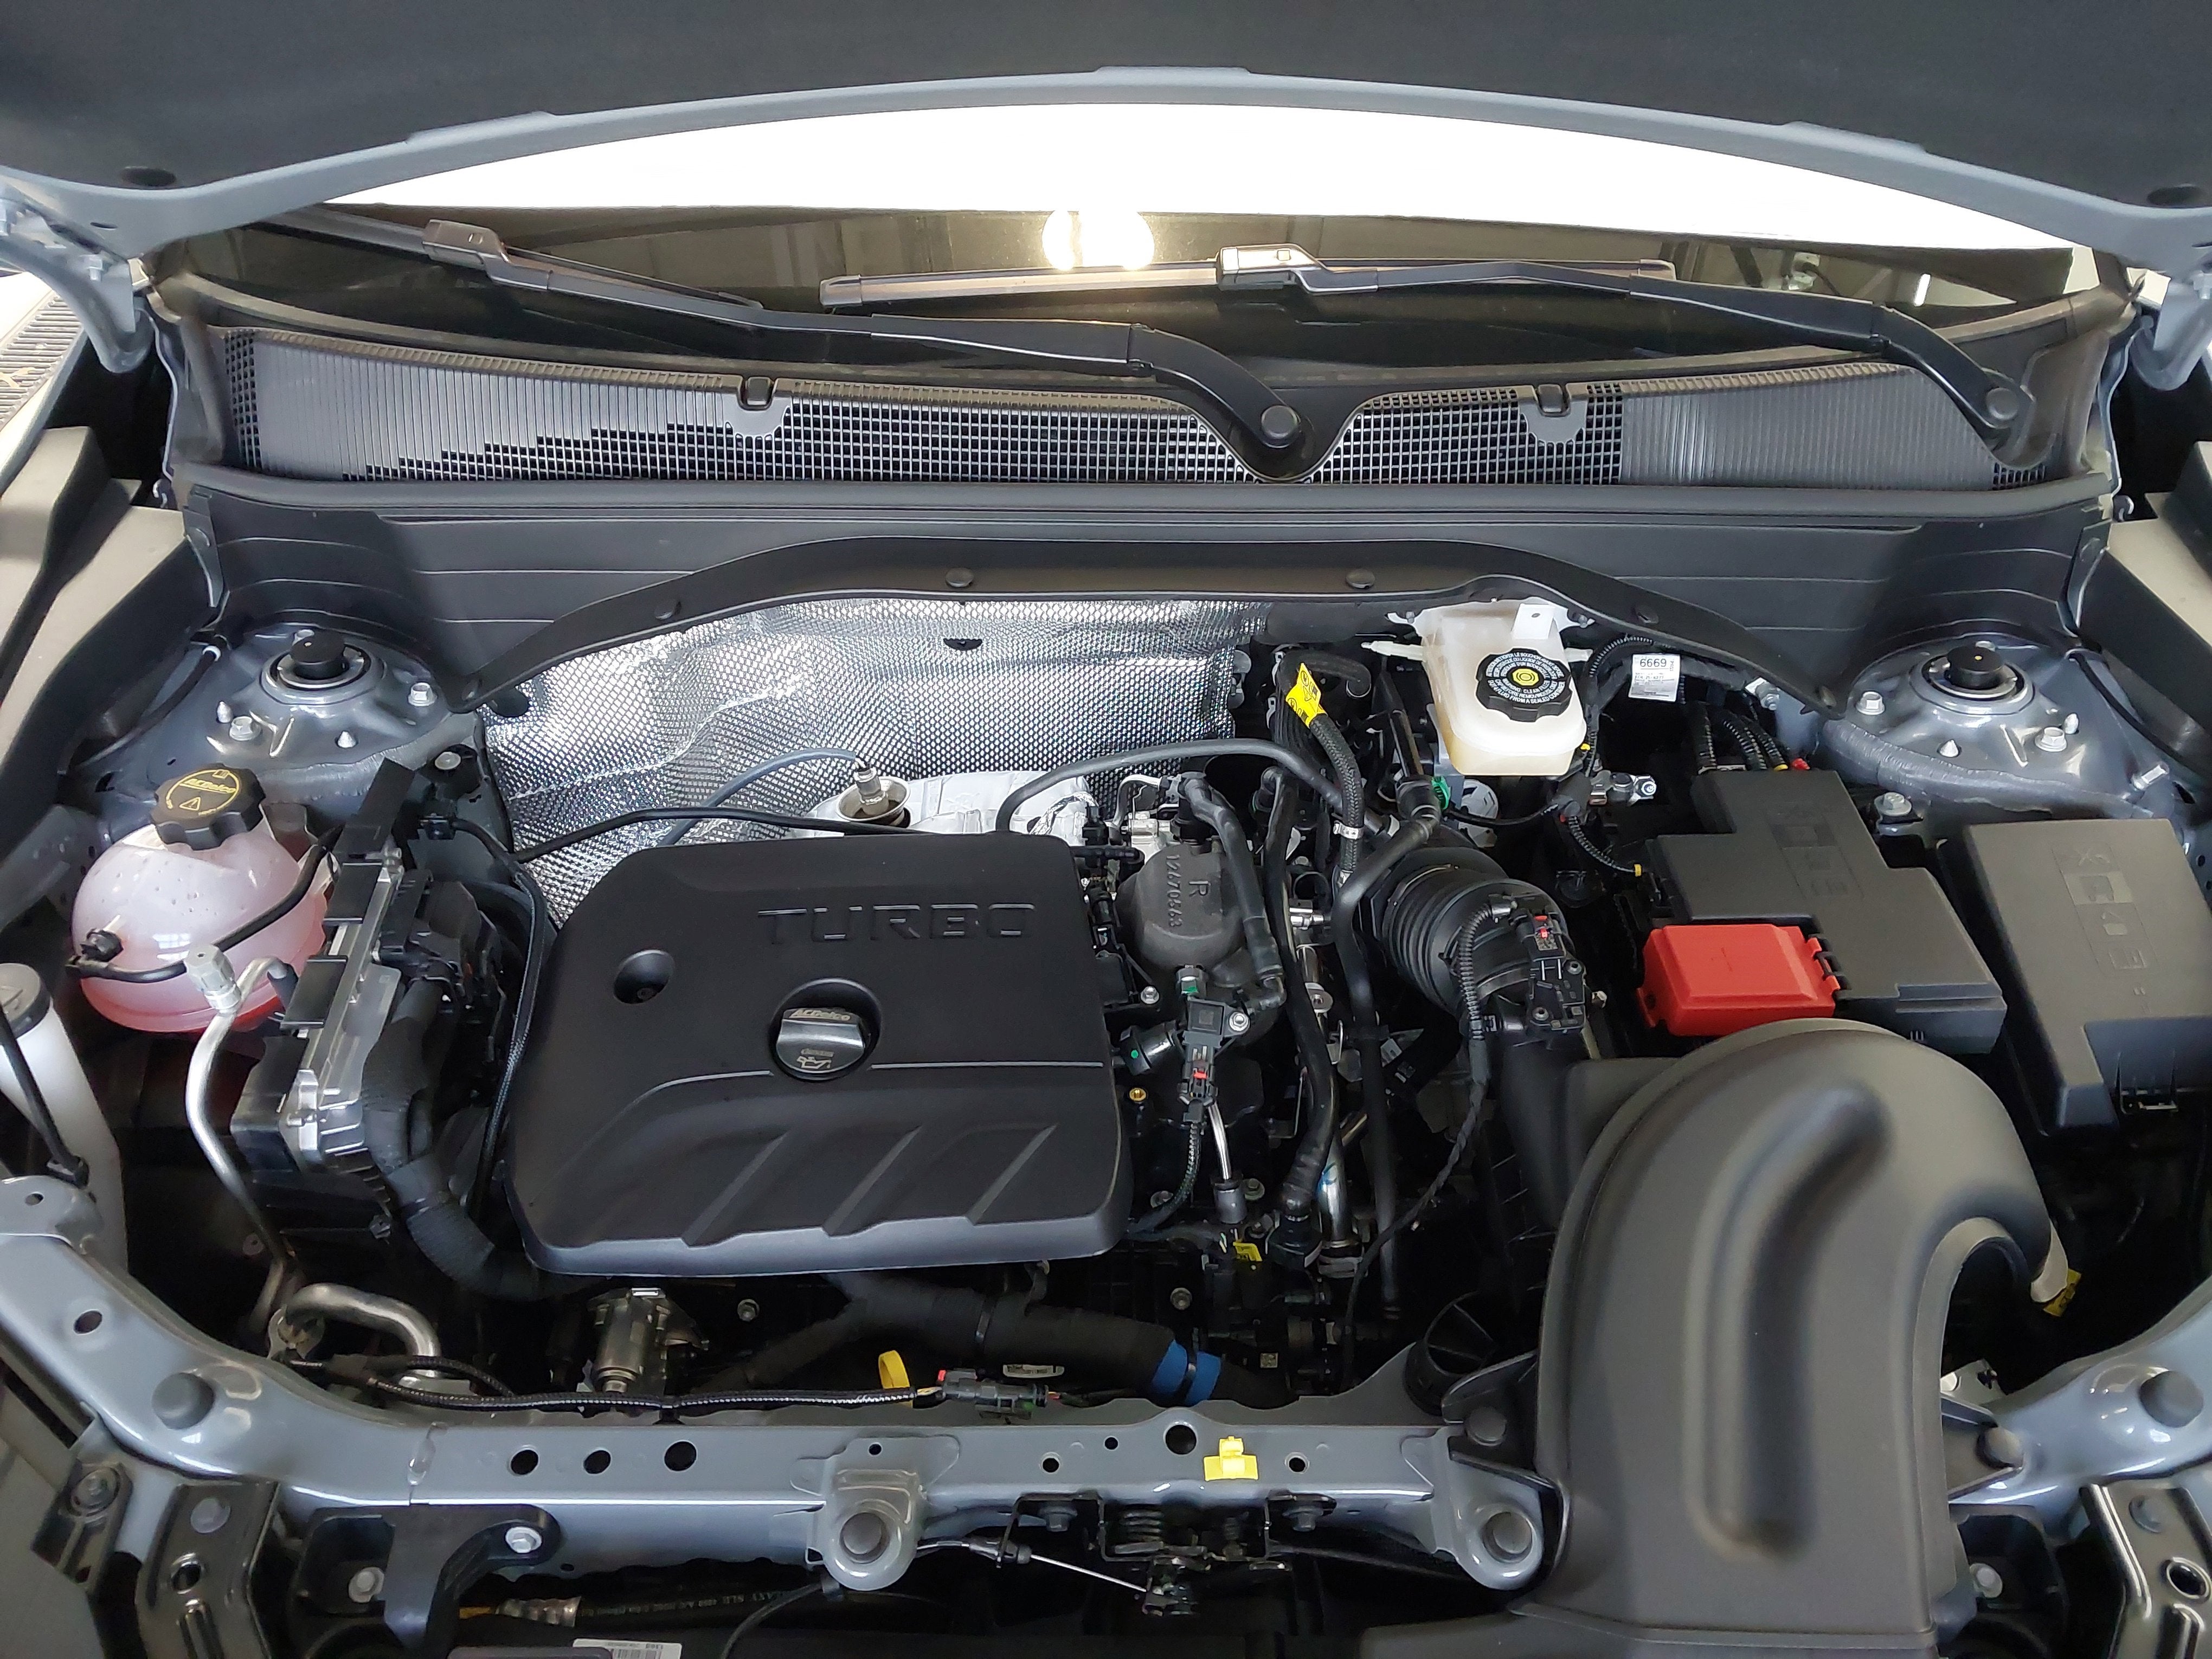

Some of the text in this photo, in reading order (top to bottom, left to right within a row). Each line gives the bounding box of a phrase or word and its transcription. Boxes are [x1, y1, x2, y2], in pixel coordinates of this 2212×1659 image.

[1640, 658, 1667, 667] 6669
[1166, 854, 1183, 927] 12670563
[1189, 880, 1211, 897] R
[758, 904, 1036, 944] TURBO
[789, 1009, 851, 1021] ACDelco
